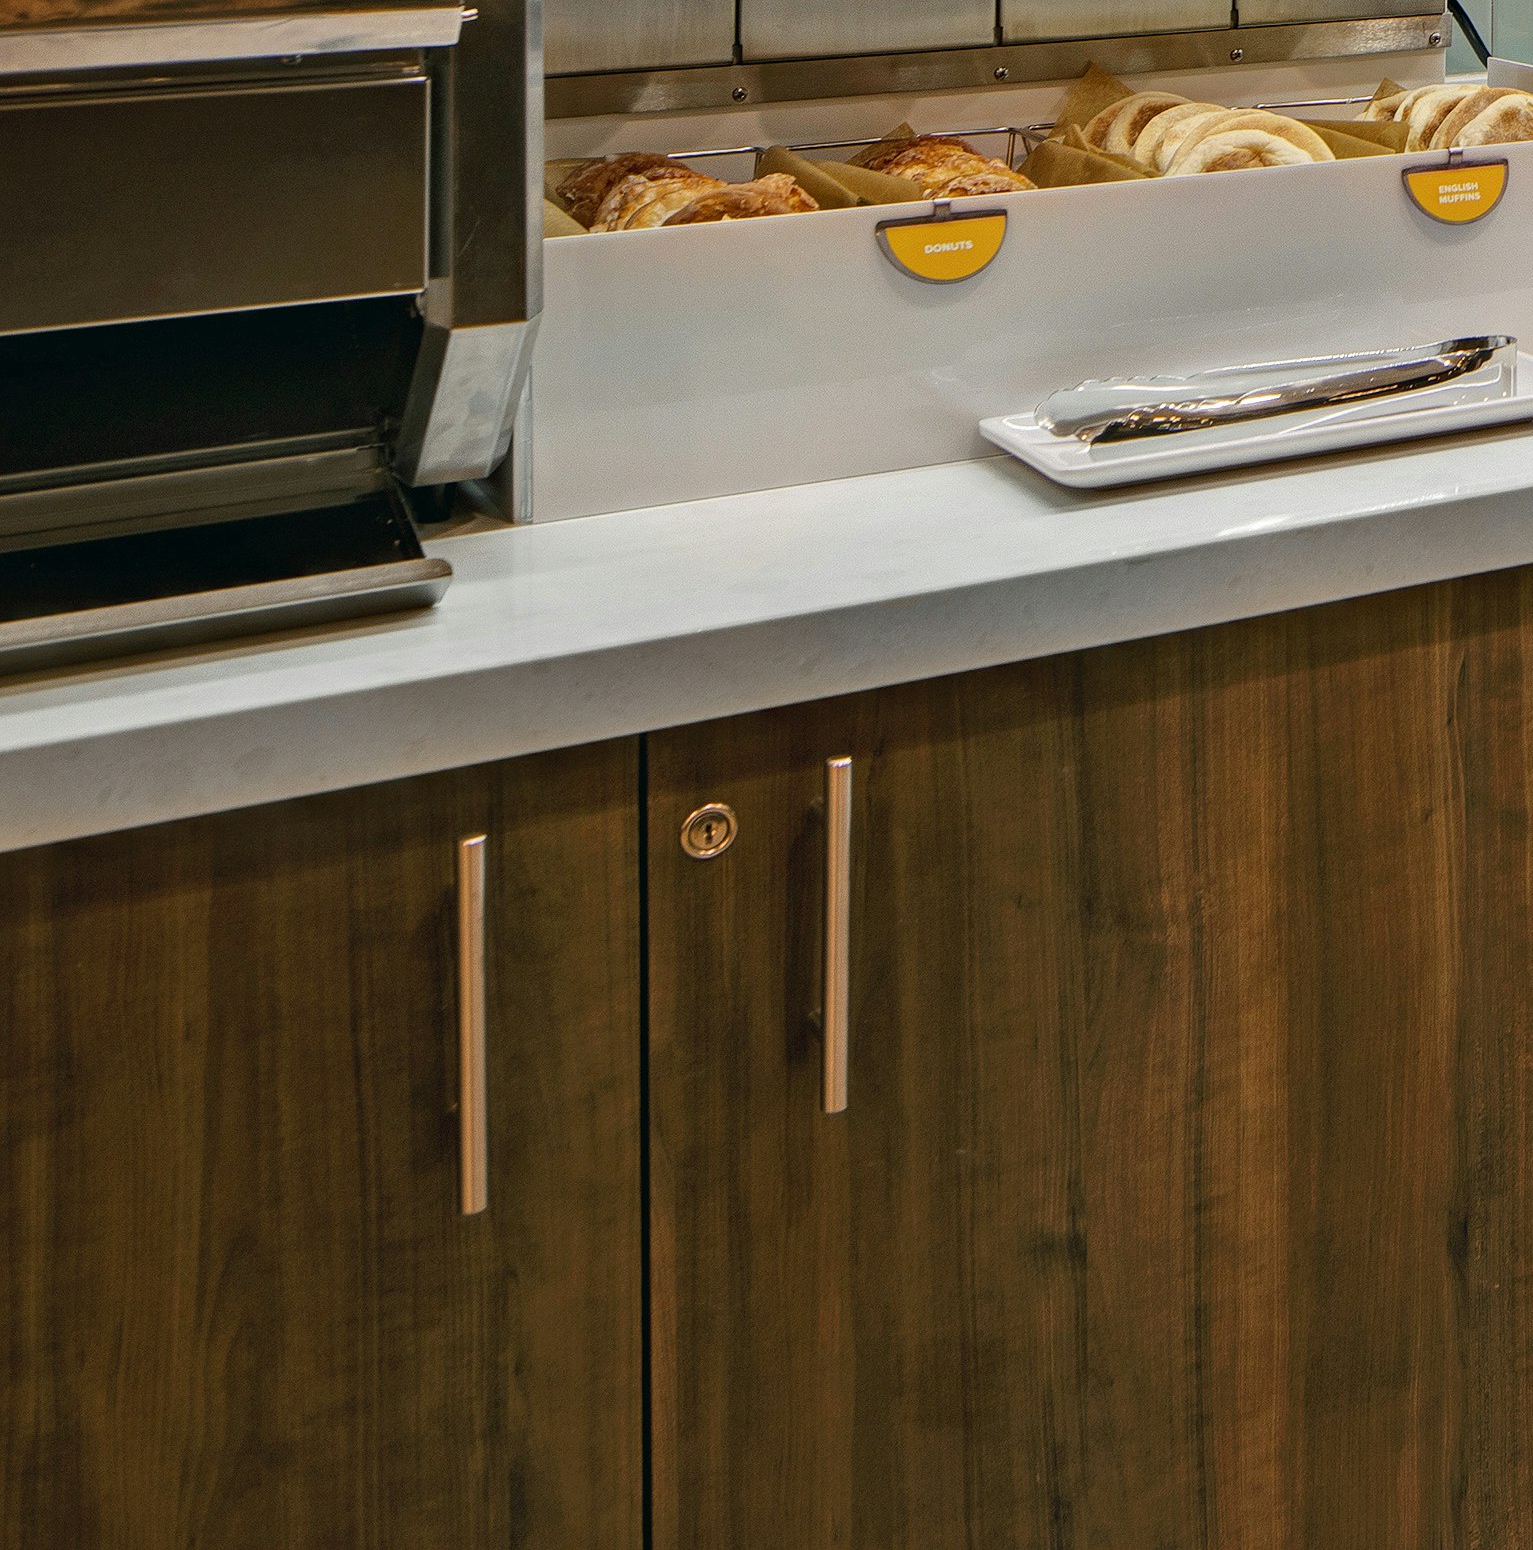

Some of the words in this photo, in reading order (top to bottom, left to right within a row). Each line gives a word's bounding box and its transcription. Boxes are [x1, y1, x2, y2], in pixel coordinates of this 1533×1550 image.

[1438, 181, 1479, 195] ENGLISH
[1438, 190, 1482, 205] MUFFINS
[924, 239, 974, 255] DONUTS
